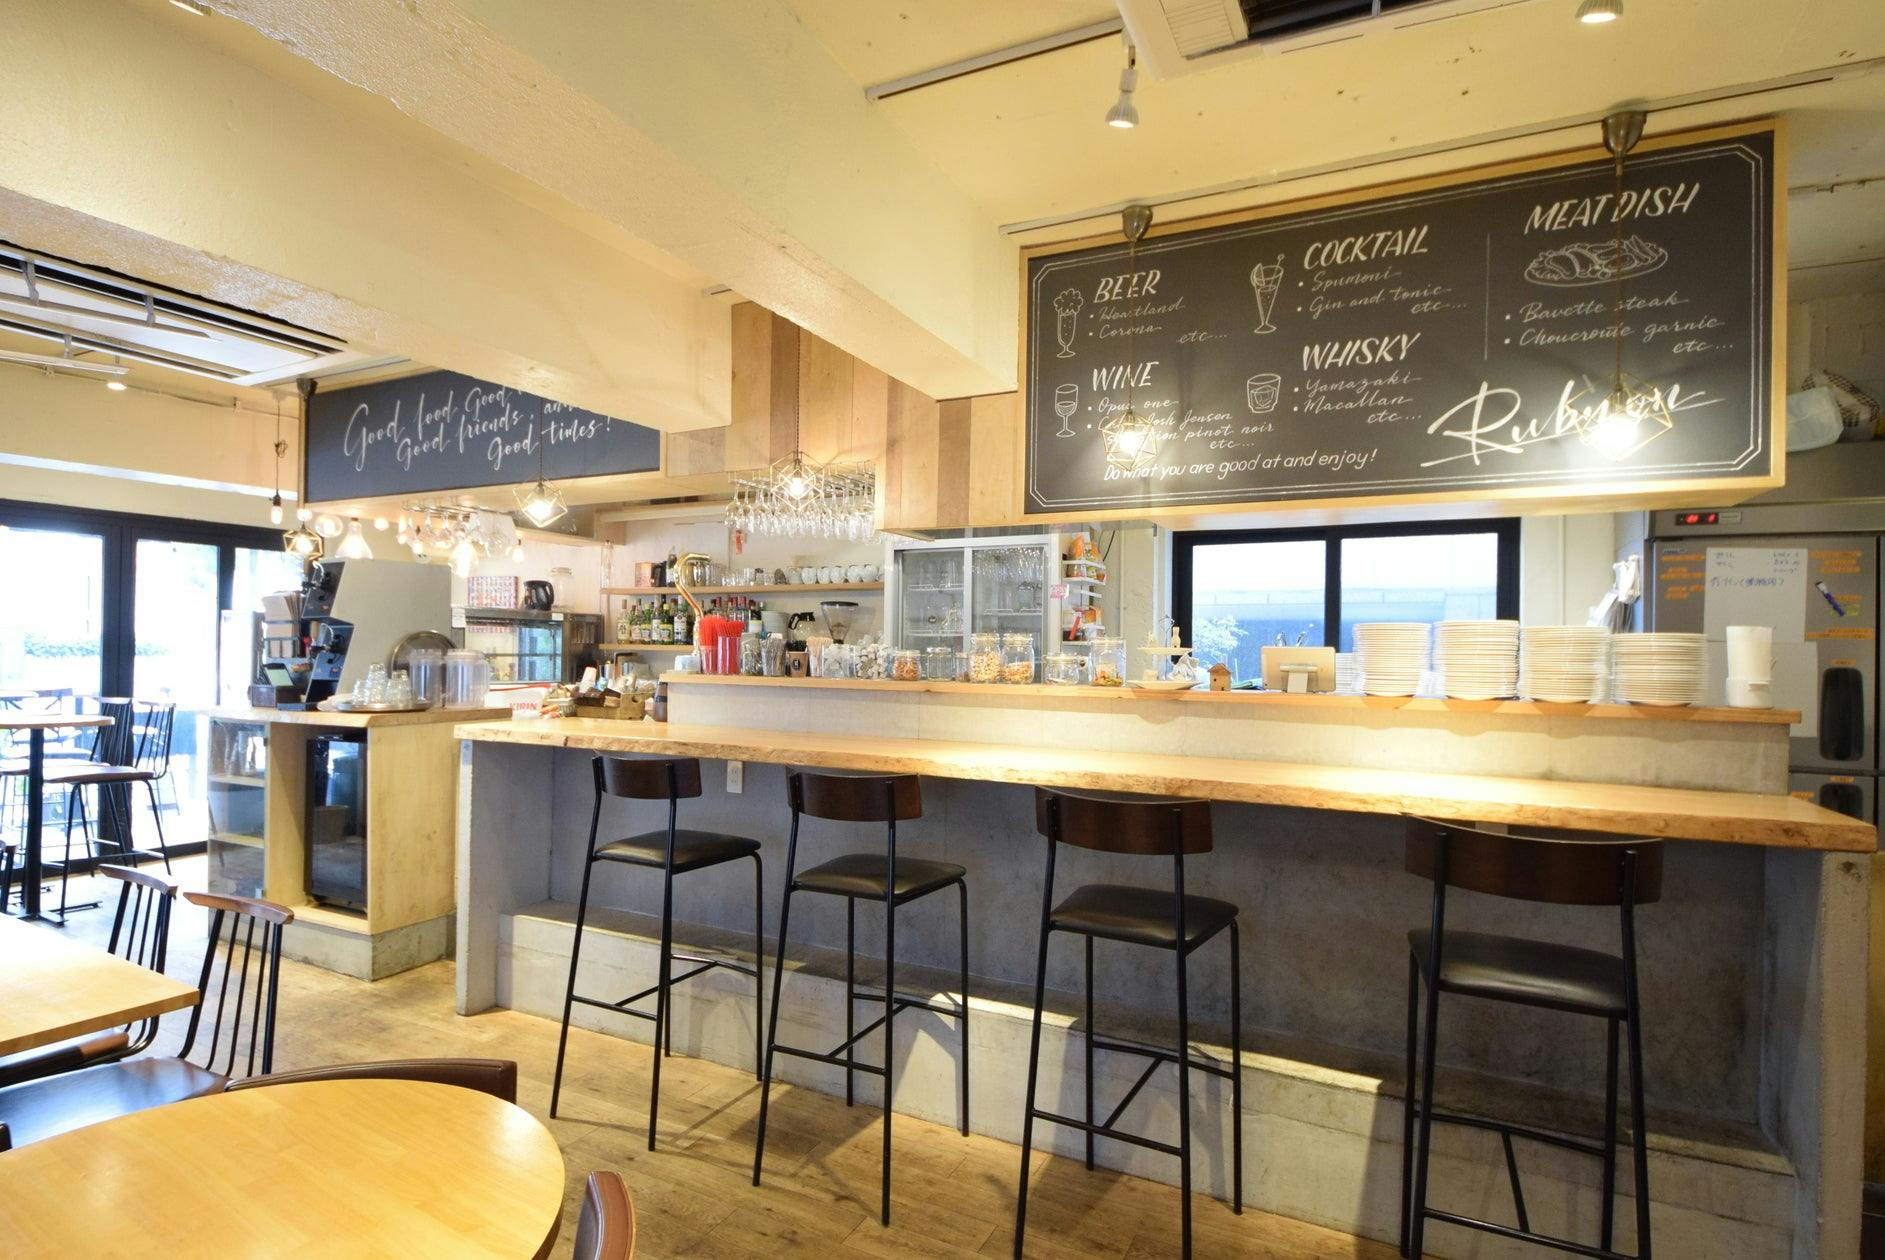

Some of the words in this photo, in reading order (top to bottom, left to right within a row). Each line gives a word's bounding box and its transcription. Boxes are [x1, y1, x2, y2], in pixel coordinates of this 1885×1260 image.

[1524, 193, 1614, 235] MEAT
[1611, 182, 1700, 223] DISH
[1303, 224, 1429, 270] COCKTAIL
[1093, 269, 1161, 303] BEER
[1309, 296, 1346, 320] Gin
[1350, 289, 1386, 308] and
[1099, 324, 1162, 340] Corona
[1302, 332, 1422, 372] WHISKY
[1092, 361, 1160, 392] WINE
[343, 399, 407, 472] Good
[464, 386, 513, 421] Good
[396, 421, 452, 472] Good
[487, 423, 540, 471] Good
[1161, 464, 1187, 481] you
[1188, 462, 1216, 474] are
[1217, 453, 1262, 481] good
[1261, 454, 1282, 469] at
[1282, 449, 1319, 468] and
[1317, 447, 1379, 472] enjoy!
